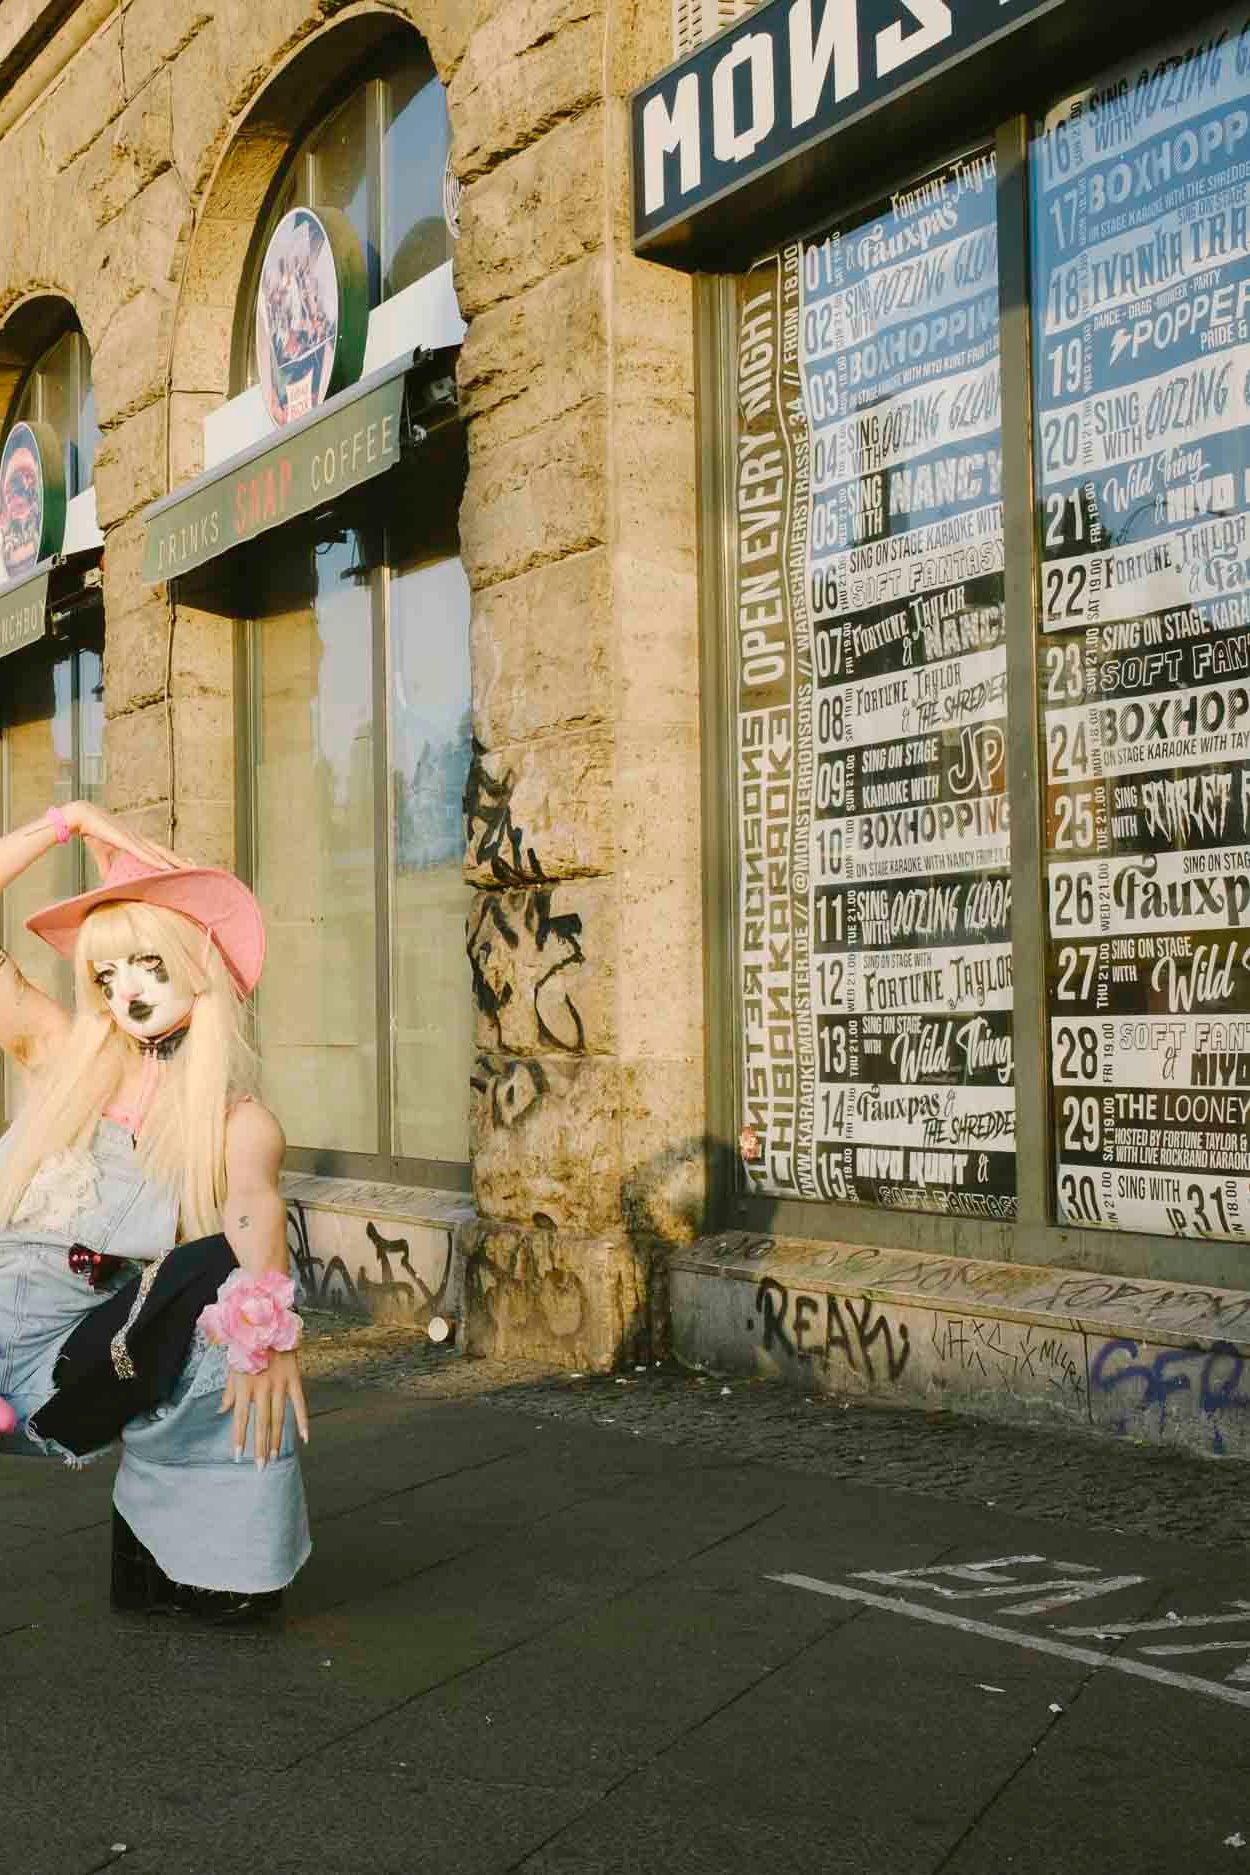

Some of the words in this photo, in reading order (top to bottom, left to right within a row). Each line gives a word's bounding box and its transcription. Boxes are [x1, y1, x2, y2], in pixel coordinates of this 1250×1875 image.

[1050, 190, 1079, 249] 17
[784, 245, 799, 301] 18.00
[805, 238, 832, 291] 01
[1050, 265, 1080, 326] 18
[784, 308, 799, 362] FROM
[805, 303, 832, 353] 02
[1200, 321, 1234, 353] PRIDE
[737, 288, 773, 420] NIGHT
[1048, 337, 1083, 397] 19
[809, 368, 840, 421] 03
[1094, 391, 1140, 435] SING
[846, 414, 881, 452] SING
[1044, 411, 1080, 472] 20
[1102, 424, 1143, 462] WITH
[1144, 360, 1234, 441] OOZING
[814, 432, 840, 485] 04
[158, 512, 221, 571] DRINKS
[312, 415, 393, 492] COFFEE
[738, 432, 784, 562] EVERY
[846, 475, 883, 514] SING
[1085, 481, 1098, 519] 19.00
[1103, 455, 1155, 513] Wild
[813, 500, 840, 549] 05
[851, 508, 883, 543] WITH
[1046, 486, 1084, 546] 21
[1089, 523, 1102, 544] FRI
[850, 549, 873, 574] SING
[890, 532, 924, 562] STAGE
[925, 512, 975, 552] KARAOKE
[1175, 515, 1247, 573] TAYLOR
[1089, 558, 1103, 593] 19.00
[1103, 542, 1172, 590] FORTUNE
[812, 562, 840, 614] 06
[851, 566, 902, 608] SOFT
[1046, 564, 1088, 622] 22
[739, 569, 785, 686] OPEN
[1087, 599, 1100, 621] SAT
[1143, 614, 1163, 647] ON
[1165, 607, 1211, 643] STAGE
[815, 627, 844, 678] 07
[852, 610, 910, 658] FORTUNE
[1086, 627, 1100, 664] 21.00
[1102, 621, 1141, 652] SING
[855, 679, 909, 717] FORTUNE
[913, 660, 963, 700] TAYLOR
[1046, 643, 1084, 701] 23
[1086, 668, 1097, 694] SUN
[1100, 649, 1183, 692] SOFT
[819, 695, 845, 744] 08
[1050, 721, 1089, 778] 24
[1090, 748, 1104, 777] MON
[1100, 687, 1250, 748] BOXHOP
[845, 754, 856, 786] 21.00
[862, 747, 887, 774] SING
[888, 744, 903, 770] ON
[904, 736, 939, 767] STAGE
[948, 725, 1006, 794] JP
[1103, 750, 1117, 768] ON
[1117, 744, 1145, 767] STAGE
[1147, 734, 1197, 762] KARAOKE
[1200, 732, 1228, 754] WITH
[792, 685, 812, 894] @MONSTERRONSONS
[816, 759, 845, 808] 09
[845, 789, 856, 812] SUN
[862, 780, 910, 809] KARAOKE
[911, 776, 940, 804] WITH
[1114, 785, 1138, 810] SING
[1054, 792, 1094, 849] 25
[1093, 786, 1107, 823] 21.00
[1095, 826, 1109, 851] TUE
[1111, 814, 1139, 840] WITH
[815, 828, 844, 875] 10
[1183, 854, 1206, 875] SING
[1208, 853, 1221, 873] ON
[1054, 871, 1094, 926] 26
[1098, 863, 1111, 900] 21.00
[816, 894, 844, 943] 11
[846, 889, 857, 922] 21.00
[857, 890, 890, 921] SING
[891, 884, 962, 937] OOZING
[1100, 903, 1111, 931] WED
[847, 925, 857, 946] TUE
[861, 919, 893, 945] WITH
[1111, 937, 1136, 961] SING
[1137, 936, 1155, 959] ON
[1156, 935, 1193, 958] STAGE
[892, 952, 913, 968] STAGE
[913, 951, 932, 968] WITH
[1057, 945, 1099, 1000] 27
[1097, 943, 1111, 981] 21.00
[1111, 964, 1139, 984] WITH
[1152, 940, 1239, 1014] Wild
[816, 959, 844, 1006] 12
[863, 969, 943, 1012] FORTUNE
[949, 953, 1014, 1010] TAYLOR
[1096, 983, 1110, 1009] THU
[848, 1020, 859, 1053] 21.00
[862, 1015, 882, 1034] SING
[897, 1015, 922, 1034] STAGE
[1101, 1023, 1115, 1058] 19.00
[1119, 1022, 1187, 1051] SOFT
[819, 1025, 847, 1074] 13
[849, 1055, 859, 1077] THU
[863, 1039, 882, 1055] WITH
[890, 1021, 954, 1084] Wild
[956, 1016, 1015, 1084] Thing
[1057, 1026, 1099, 1080] 28
[1102, 1063, 1114, 1083] FRI
[821, 1089, 846, 1137] 14
[922, 1117, 947, 1149] THE
[856, 1084, 941, 1125] Fauxpas
[1062, 1095, 1101, 1152] 29
[1102, 1097, 1116, 1130] 19.00
[1115, 1092, 1158, 1121] THE
[1163, 1094, 1250, 1126] LOONEY
[1103, 1132, 1116, 1162] SAT
[1114, 1127, 1149, 1147] HOSTED
[1149, 1129, 1162, 1148] BY
[1163, 1130, 1204, 1150] FORTUNE
[1205, 1132, 1238, 1152] TAYLOR
[1116, 1145, 1139, 1164] WITH
[1139, 1146, 1159, 1166] LIVE
[1160, 1147, 1208, 1169] ROCKBAND
[819, 1151, 847, 1200] 15
[910, 1150, 970, 1189] KUNT
[1061, 1174, 1102, 1225] 30
[1101, 1171, 1115, 1209] 21.00
[1117, 1175, 1146, 1201] SING
[1149, 1177, 1181, 1203] WITH
[1187, 1183, 1231, 1236] 31
